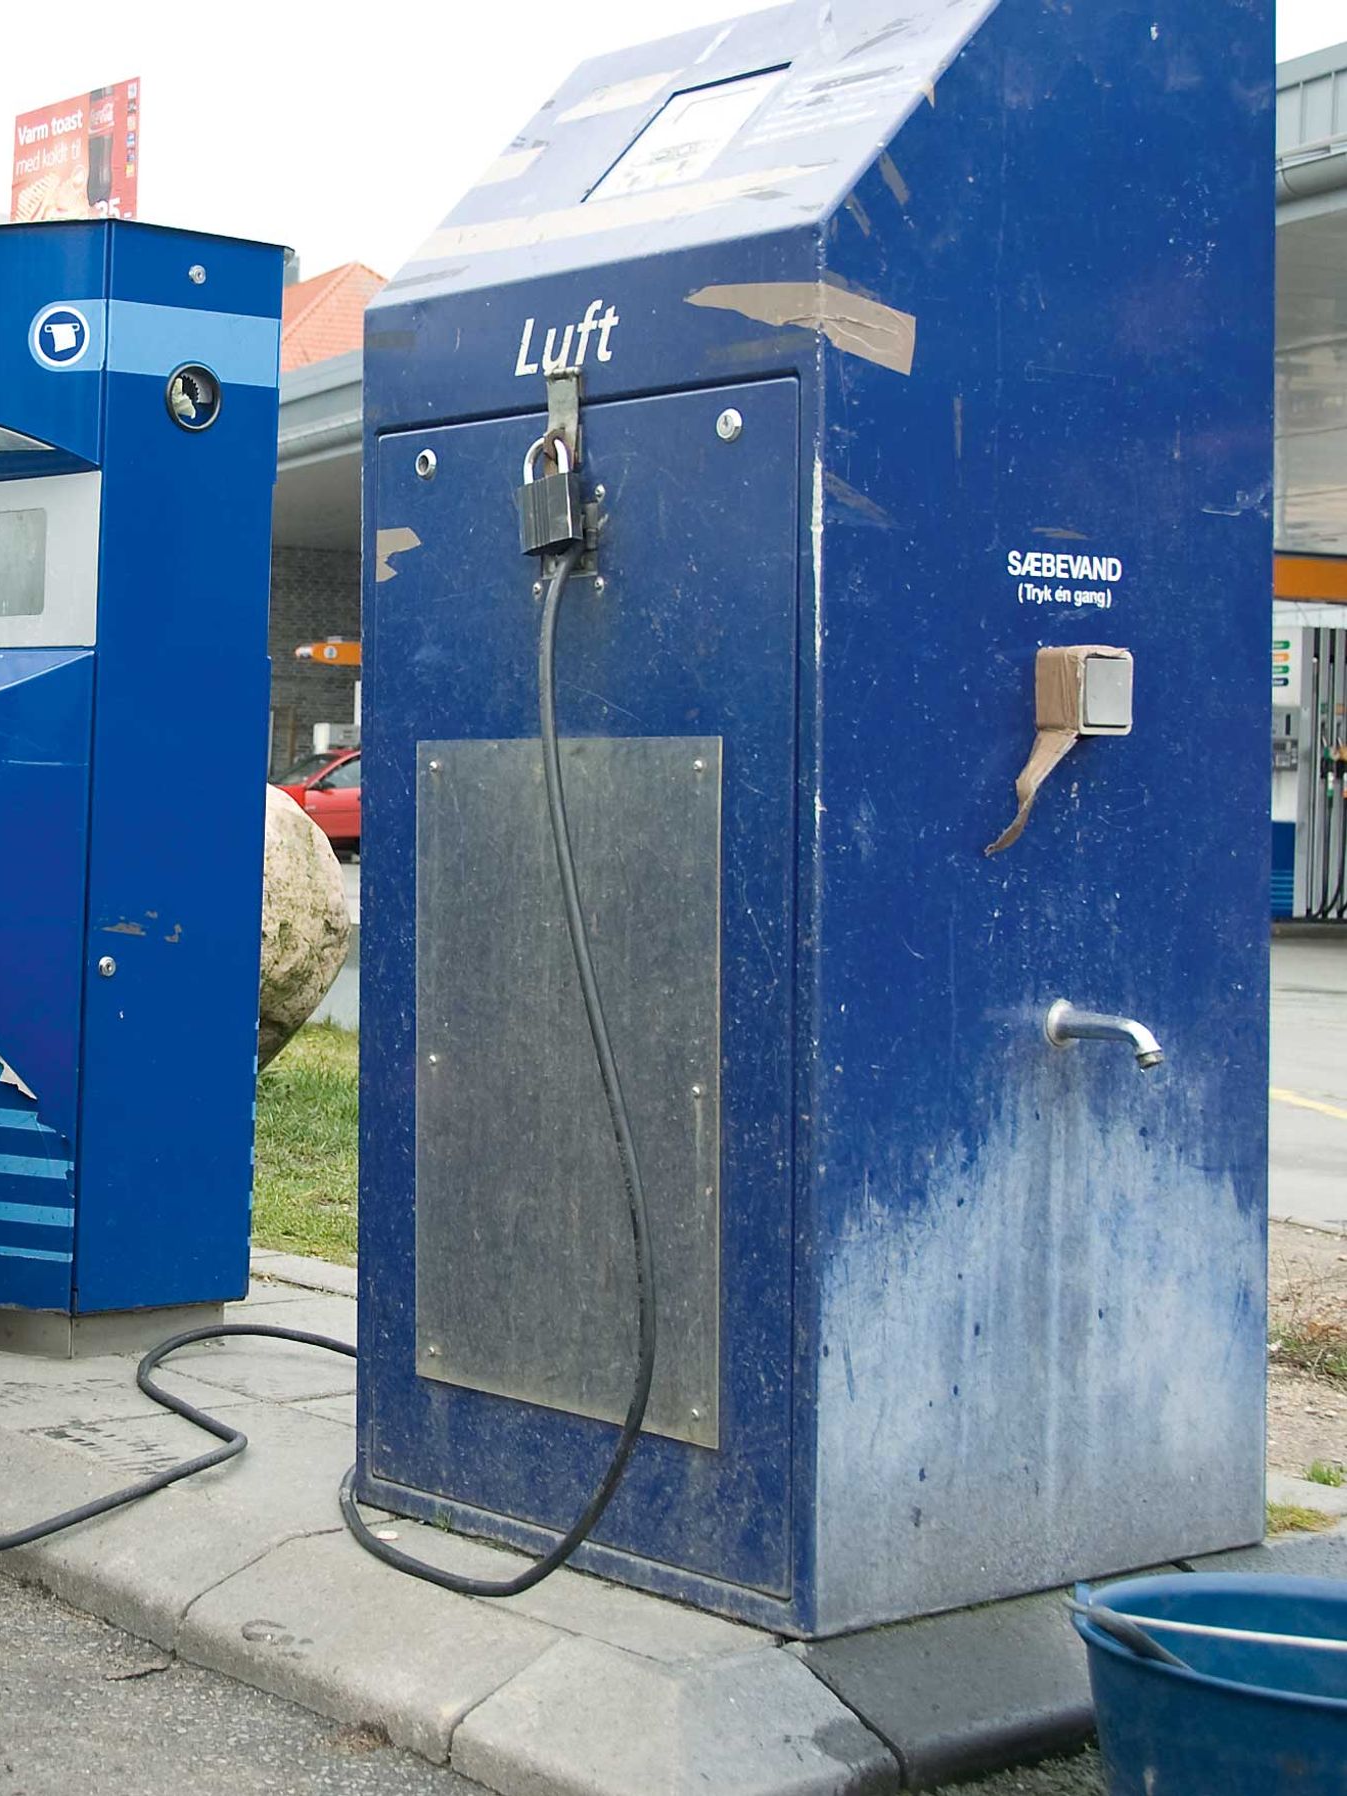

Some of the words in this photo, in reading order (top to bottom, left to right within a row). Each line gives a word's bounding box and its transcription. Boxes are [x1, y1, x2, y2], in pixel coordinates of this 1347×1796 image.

[18, 123, 49, 146] Varm
[51, 108, 84, 136] toast
[16, 149, 40, 176] med
[514, 299, 620, 377] Luft
[1007, 550, 1122, 582] SÆBEVAND
[1018, 582, 1053, 605] (Tryk
[1054, 585, 1072, 602] én
[1073, 588, 1112, 608] gang)
